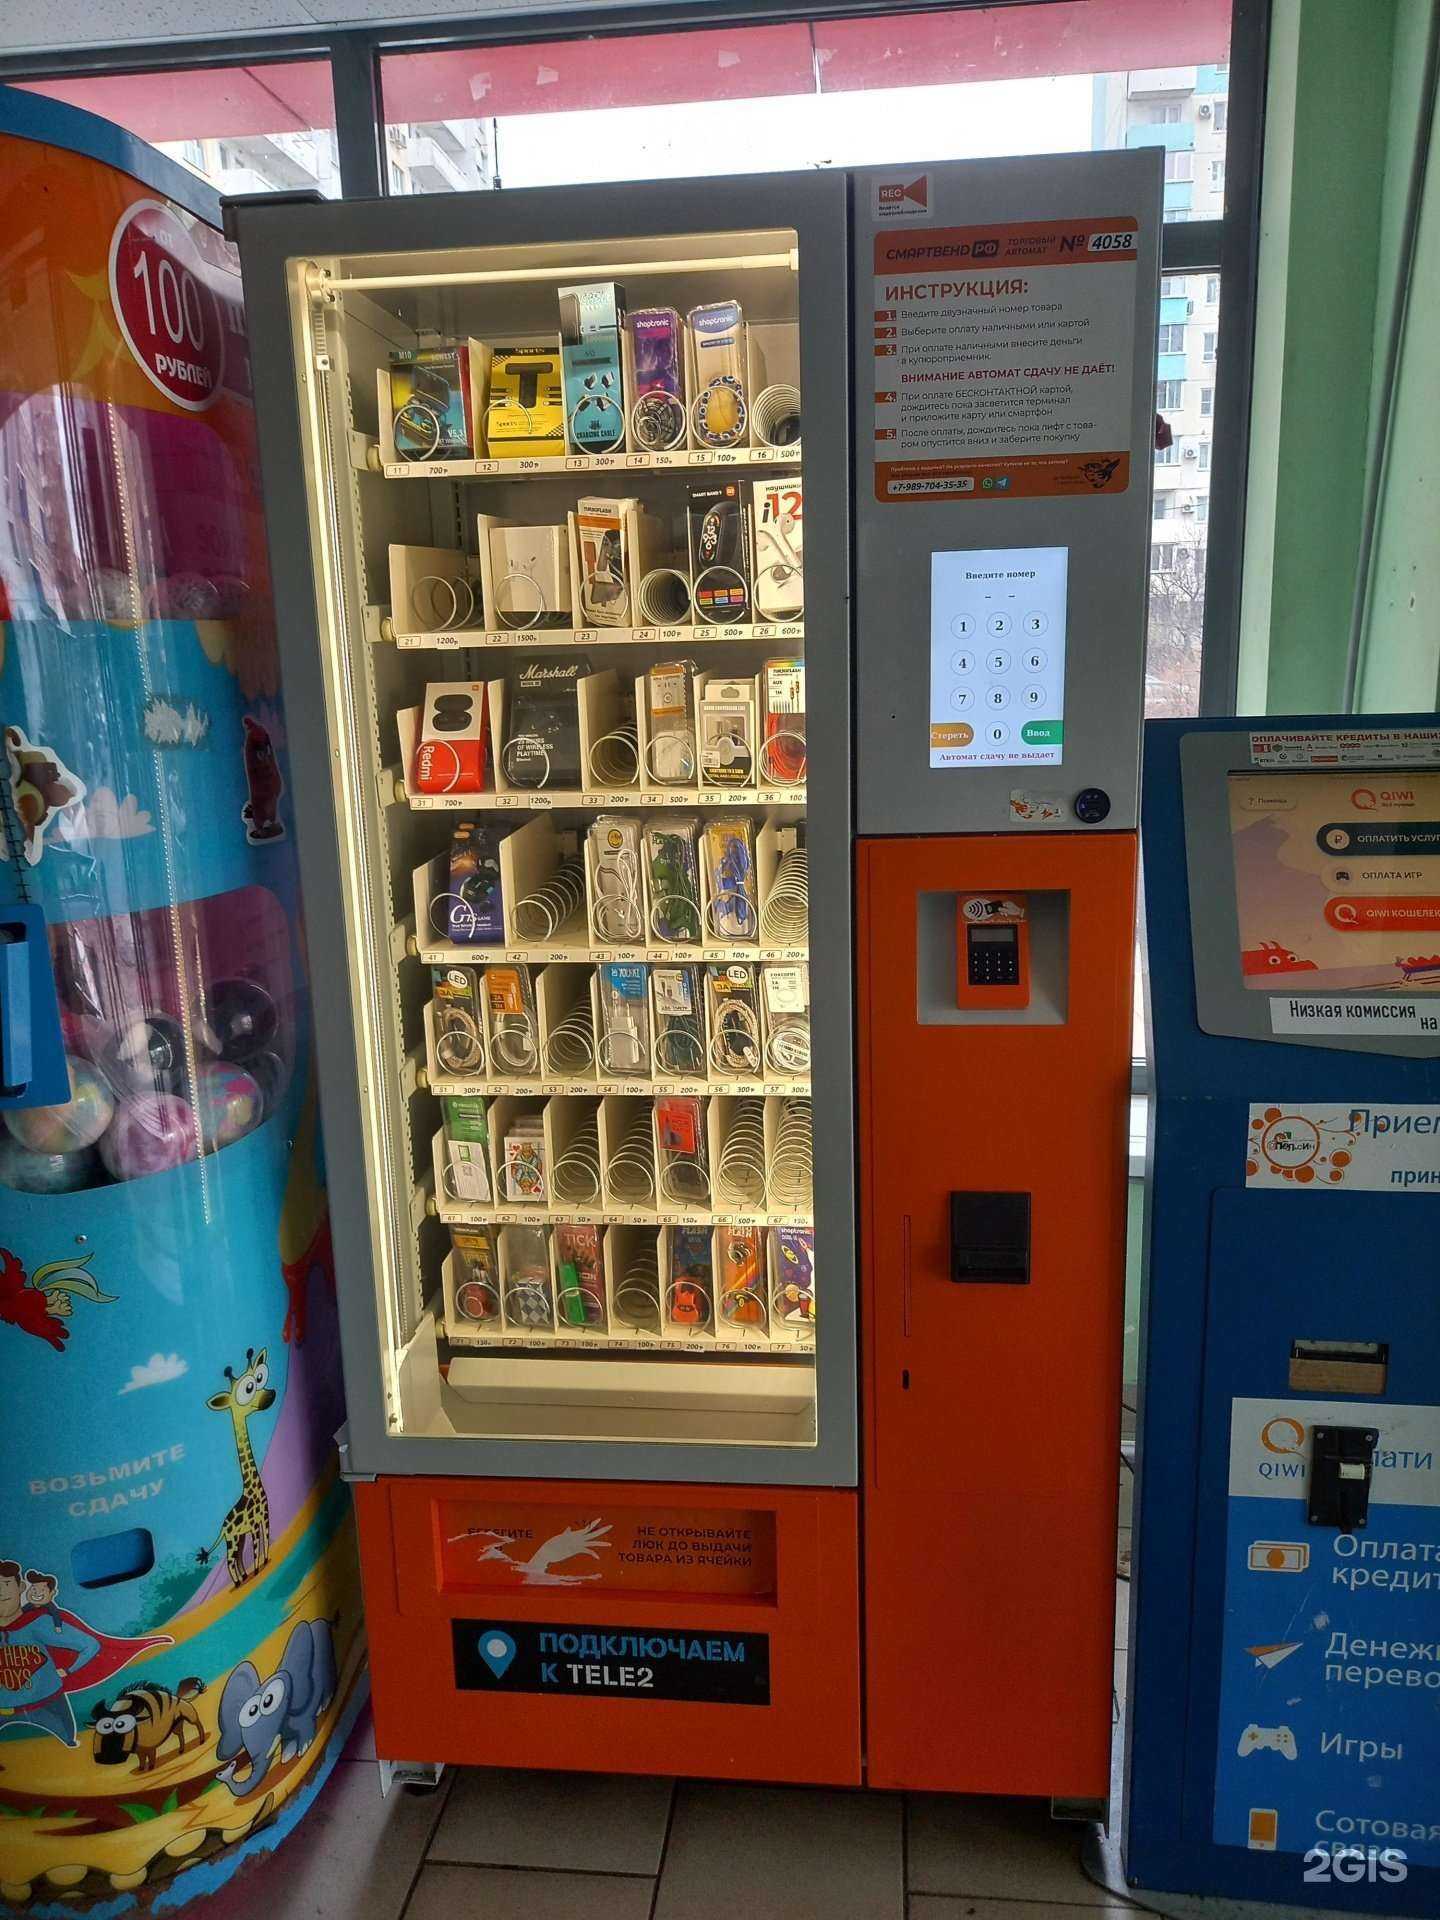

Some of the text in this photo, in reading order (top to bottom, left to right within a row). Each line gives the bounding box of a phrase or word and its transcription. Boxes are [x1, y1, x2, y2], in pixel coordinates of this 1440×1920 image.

[881, 188, 903, 199] REC
[1092, 233, 1133, 250] 4058
[887, 241, 998, 260] СМАРТВЕНД РФ
[885, 279, 1029, 301] ИНСТРУКЦИЯ:
[133, 249, 205, 352] 100
[901, 309, 939, 319] Введите
[941, 304, 996, 318] двузначный
[998, 304, 1029, 314] номер
[1031, 302, 1063, 313] товара
[636, 318, 670, 329] shoptronic
[698, 315, 735, 327] shoptronic
[901, 326, 947, 337] Выберите
[982, 321, 1036, 332] наличными
[1037, 320, 1056, 329] или
[1057, 318, 1090, 329] картой
[901, 345, 919, 356] При
[922, 343, 954, 353] оплате
[955, 341, 1009, 351] наличными
[1010, 339, 1048, 349] внесите
[1049, 337, 1083, 348] деньги
[901, 363, 1116, 383] ВНИМАНИЕ АВТОМАТ СДАЧУ НЕ ДАЁТ!
[901, 391, 919, 402] При
[922, 391, 954, 401] оплате
[955, 384, 1038, 399] БЕСКОНТАКТНОЙ
[901, 396, 1072, 413] дождитесь пока засветится терминал
[909, 412, 960, 424] приложите
[961, 411, 986, 422] карту
[987, 410, 1006, 418] или
[1007, 407, 1053, 419] смартфон
[901, 428, 929, 437] После
[966, 424, 1017, 436] дождитесь
[1017, 424, 1041, 432] пока
[1041, 421, 1065, 433] лифт
[901, 440, 920, 450] ром
[920, 438, 966, 449] опустится
[967, 437, 989, 445] вниз
[999, 433, 1041, 445] заберите
[1042, 432, 1081, 444] покупку
[965, 568, 1037, 580] Введите номер
[960, 619, 1040, 632] 1 2 3
[958, 656, 1040, 669] 4 5 6
[520, 664, 579, 681] Marshall
[958, 692, 1038, 705] 7 8 9
[993, 728, 1002, 740] 0
[1335, 732, 1390, 743] КРЕДИТЫ
[1392, 733, 1401, 741] В
[420, 744, 436, 782] Redmi
[939, 751, 1055, 763] Автомат сдачу не выдает
[1379, 789, 1415, 802] QIWI
[1357, 834, 1409, 844] ОПЛАТИТЬ
[1361, 871, 1423, 880] ОПЛАТА ИГР
[1366, 909, 1390, 918] QIWI
[448, 971, 467, 984] LED
[728, 970, 747, 979] LED
[1290, 1001, 1416, 1020] Низкая комиссия
[1420, 1017, 1438, 1031] на
[28, 1443, 187, 1498] ВОЗЬМИТЕ
[1258, 1462, 1306, 1480] QIWI
[68, 1479, 166, 1518] СДАЧУ
[638, 1526, 753, 1540] НЕ ОТКРЫВАЙТЕ
[633, 1540, 753, 1554] ЛЮК ДО ВЫДАЧИ
[619, 1551, 753, 1568] ТОВАРА ИЗ ЯЧЕЙКИ
[539, 1631, 746, 1663] ПОДКЛЮЧАЕМ
[1325, 1632, 1440, 1661] Денеж
[542, 1663, 656, 1688] К TELE2
[1320, 1732, 1403, 1762] Игры
